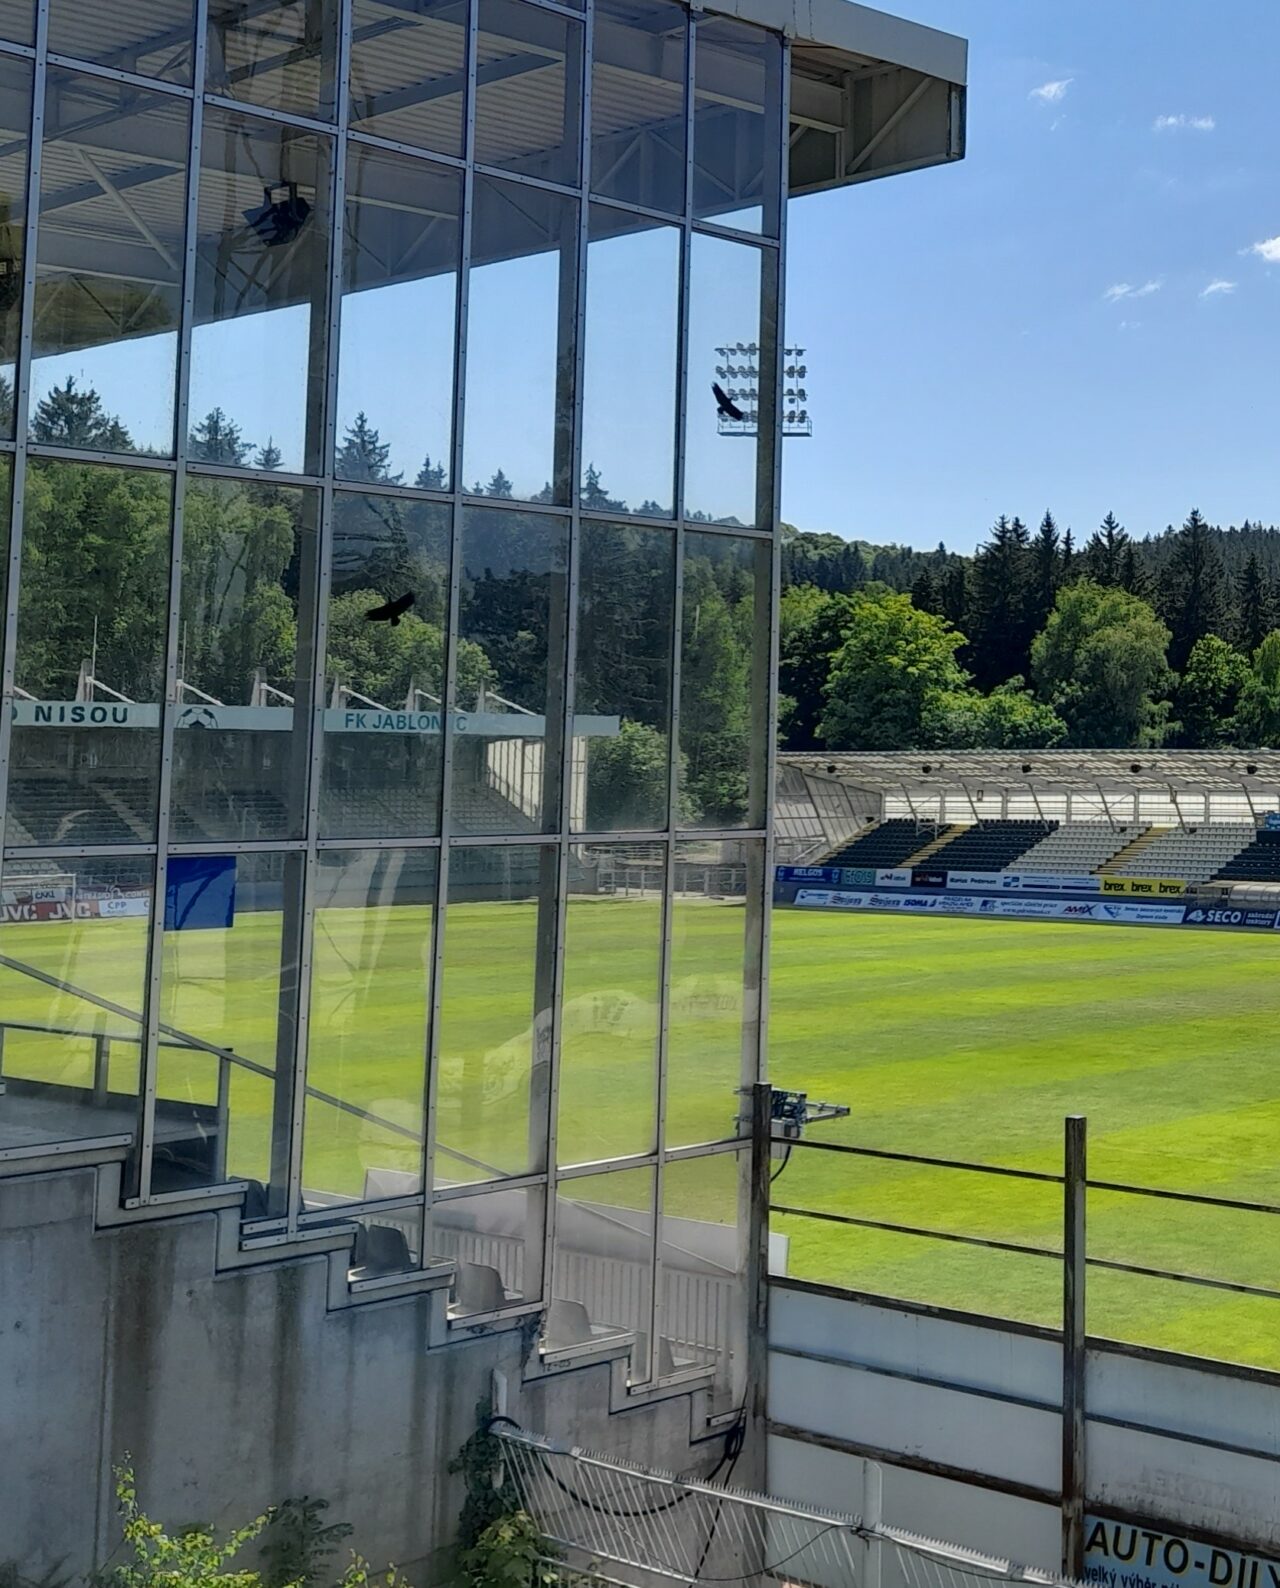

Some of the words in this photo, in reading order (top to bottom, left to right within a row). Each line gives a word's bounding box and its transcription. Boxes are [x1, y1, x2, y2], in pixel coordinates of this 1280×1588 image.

[35, 705, 128, 724] NISOU
[345, 713, 367, 728] FK
[372, 714, 467, 731] JABLONC
[1103, 880, 1125, 892] brex
[1131, 881, 1152, 893] brex
[1159, 882, 1182, 894] brex
[107, 901, 127, 910] CPP
[1206, 910, 1242, 923] SECO
[1084, 1565, 1117, 1588] velký
